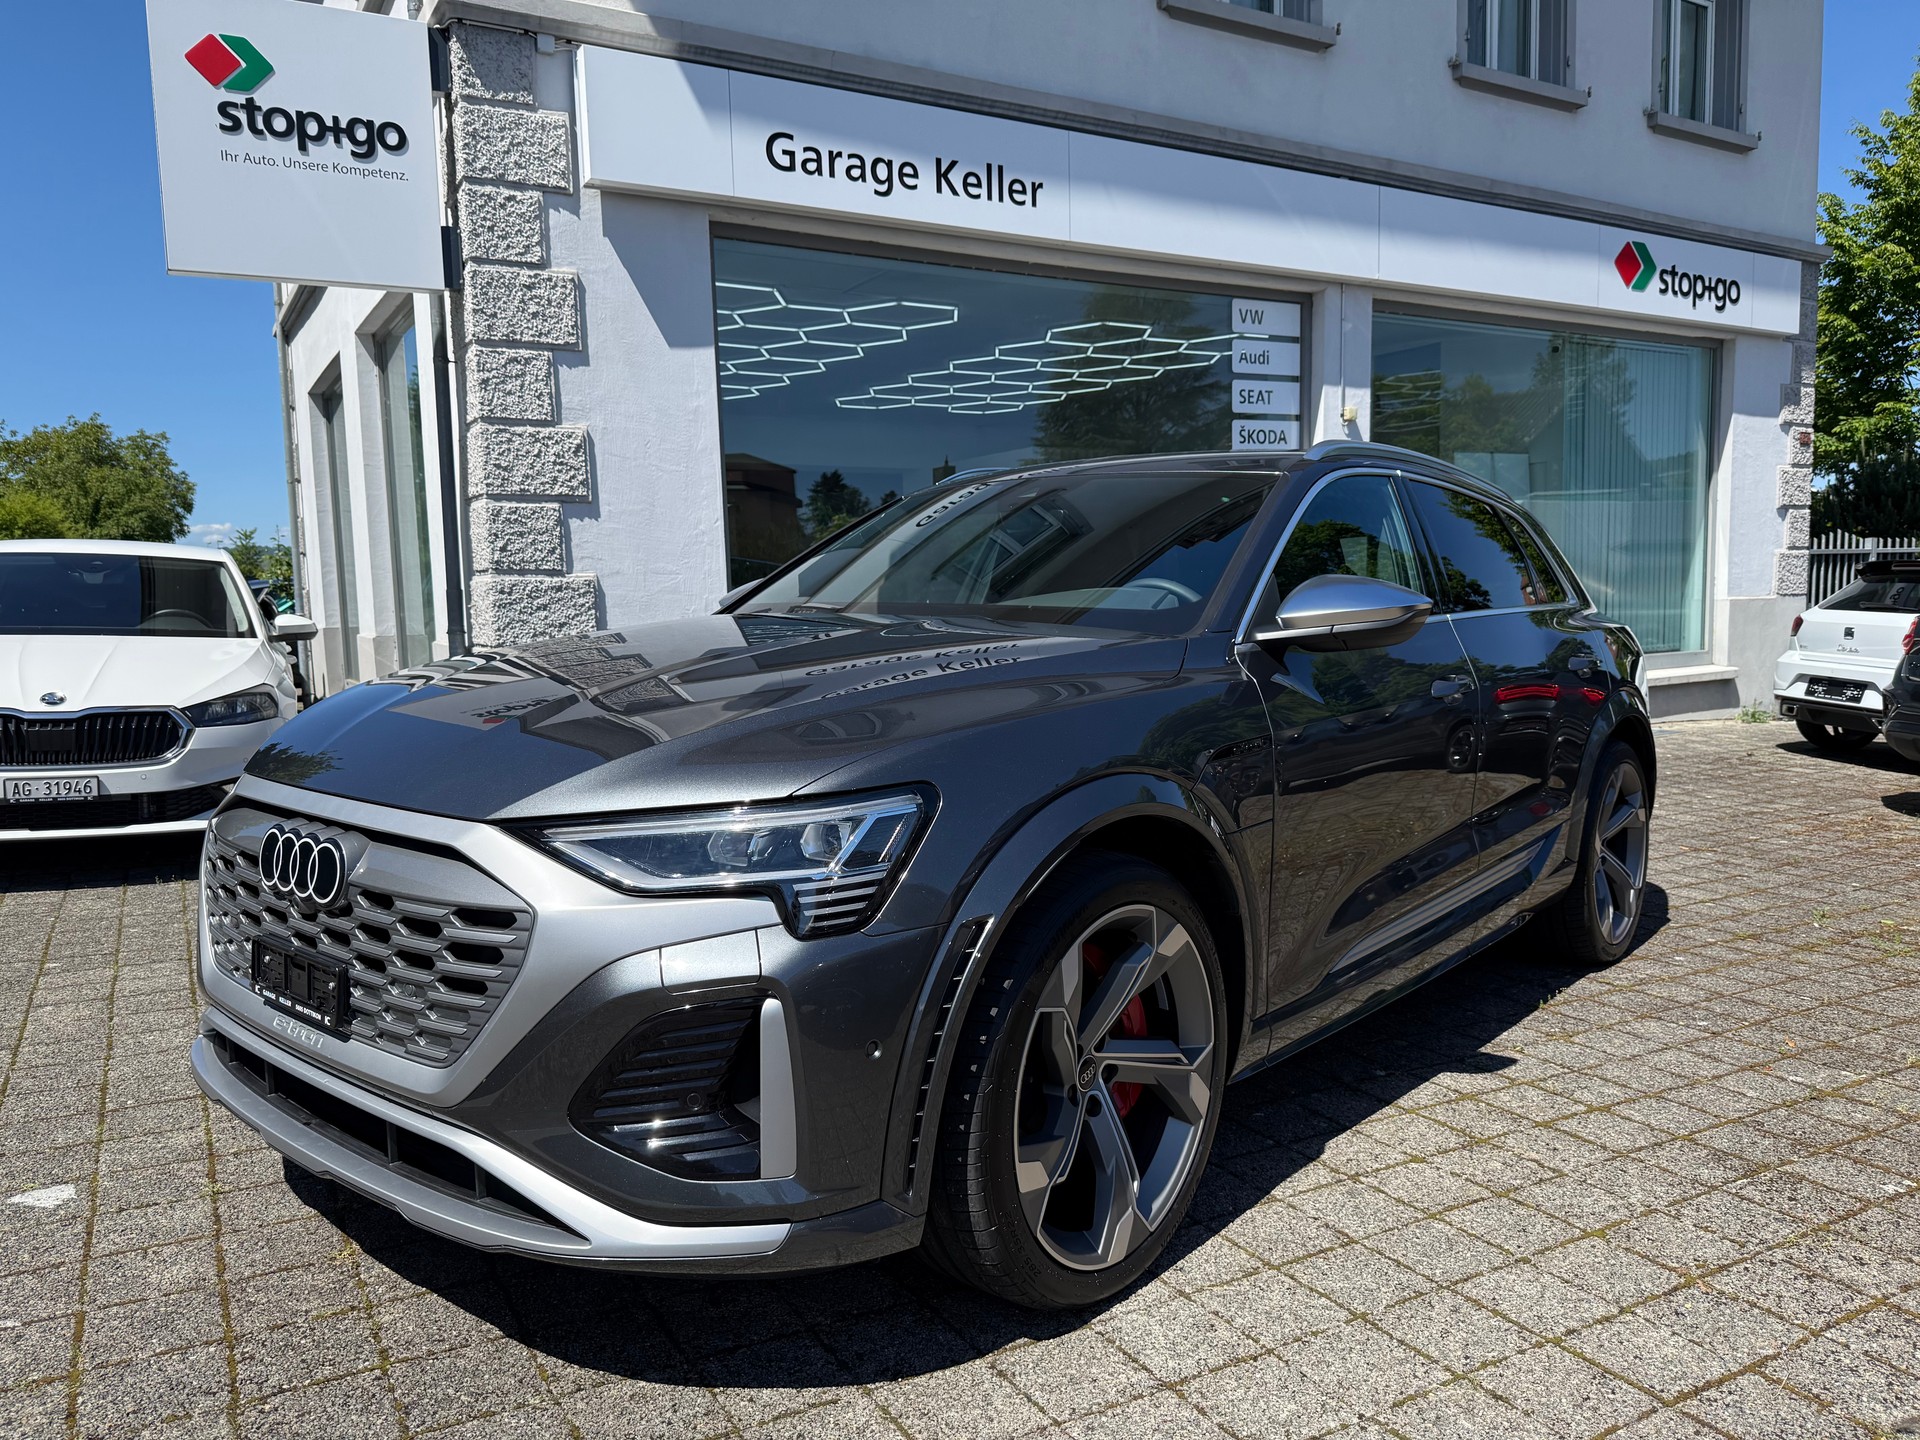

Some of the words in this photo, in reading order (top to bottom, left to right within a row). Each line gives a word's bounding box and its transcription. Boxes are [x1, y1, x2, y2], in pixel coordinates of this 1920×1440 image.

[217, 97, 408, 160] stop+go
[220, 149, 240, 163] Ihr
[243, 153, 279, 168] Auto.
[282, 157, 329, 173] Unsere
[332, 161, 409, 181] Kompetenz.
[765, 132, 919, 197] Garage
[935, 157, 1044, 208] Keller
[1659, 264, 1741, 312] stop+go
[1238, 307, 1265, 326] VW
[1238, 349, 1270, 366] Audi
[1238, 388, 1274, 405] SEAT
[1238, 425, 1288, 445] ŠKODA
